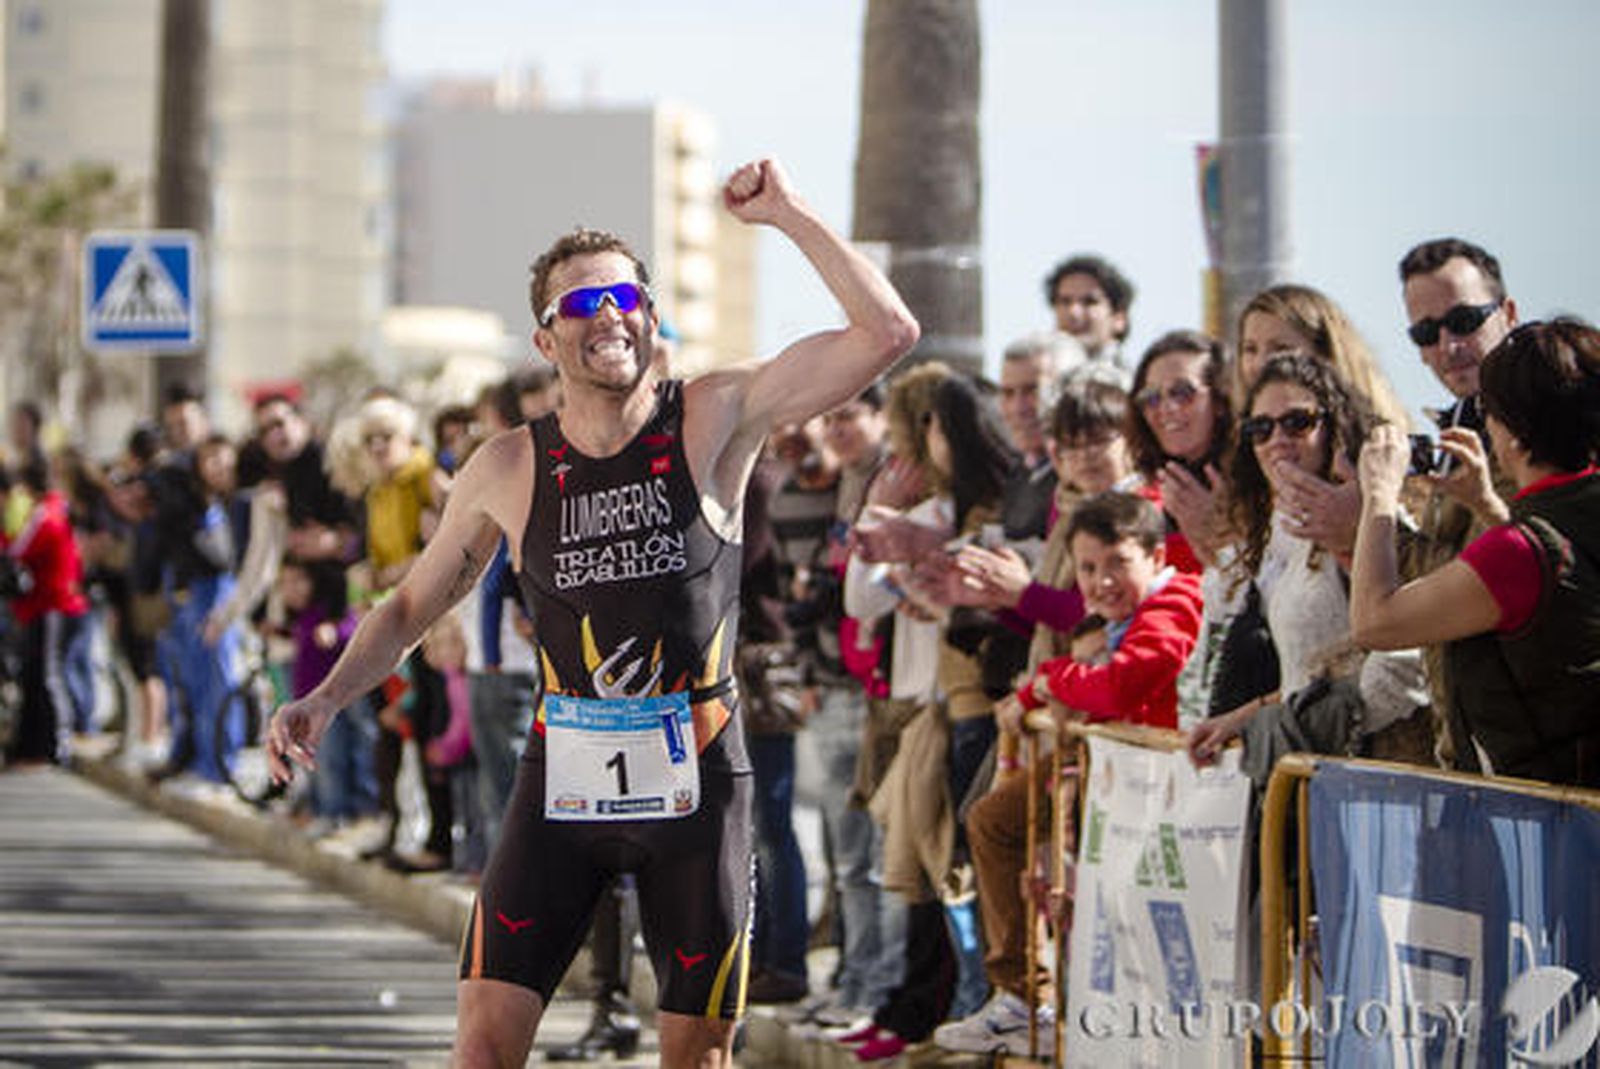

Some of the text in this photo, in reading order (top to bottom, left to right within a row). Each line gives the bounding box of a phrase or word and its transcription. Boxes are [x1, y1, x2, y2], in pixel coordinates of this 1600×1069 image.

[560, 478, 672, 544] LUMBRERAS
[553, 529, 684, 572] TRIATLÓN
[555, 553, 687, 589] DIABLILLOS
[605, 751, 629, 795] 1
